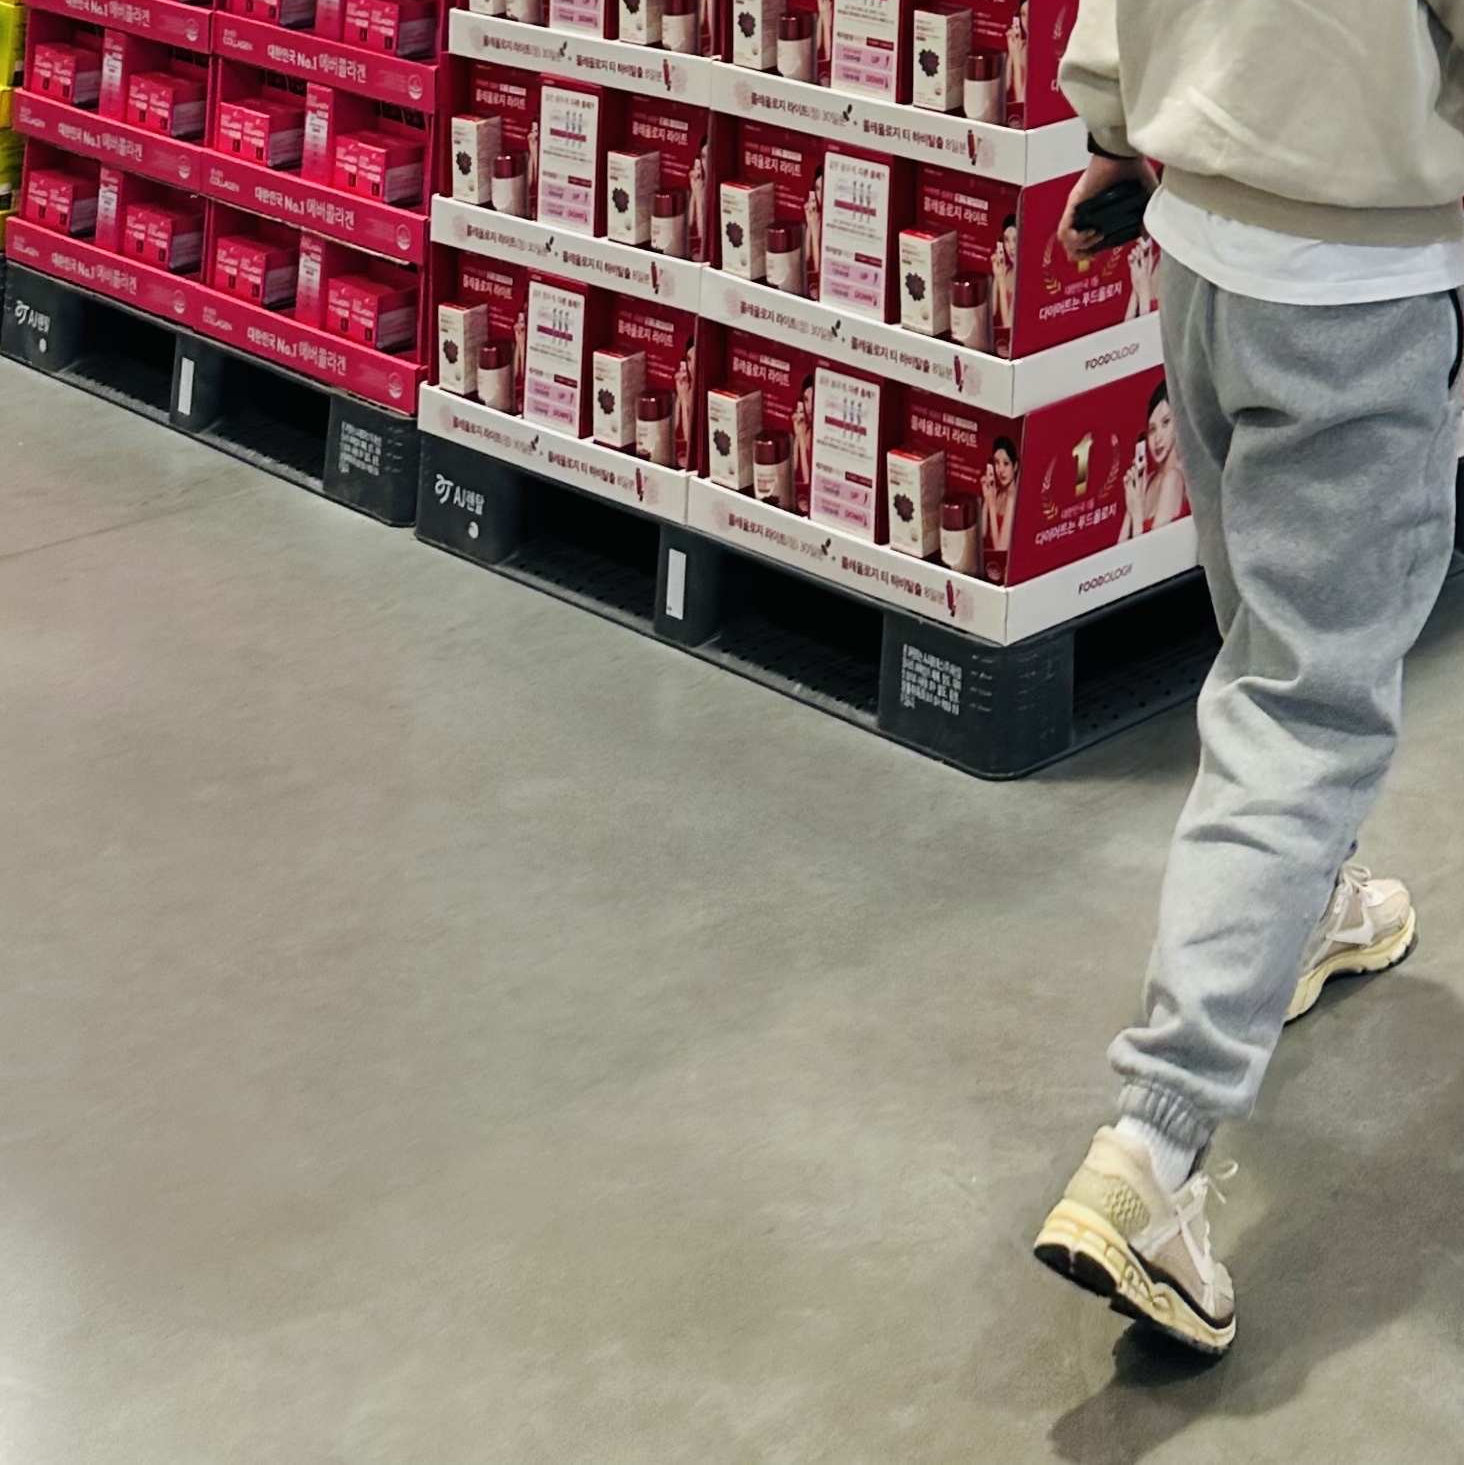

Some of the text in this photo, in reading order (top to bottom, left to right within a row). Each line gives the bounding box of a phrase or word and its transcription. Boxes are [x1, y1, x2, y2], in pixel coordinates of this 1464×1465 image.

[1039, 299, 1080, 320] 다이어트는
[1085, 344, 1140, 371] FOODOLOGY
[1072, 433, 1093, 496] 1
[453, 485, 485, 516] AJ렌탈
[1035, 522, 1076, 546] 다이어트는
[1078, 564, 1133, 594] FOODOLOGY
